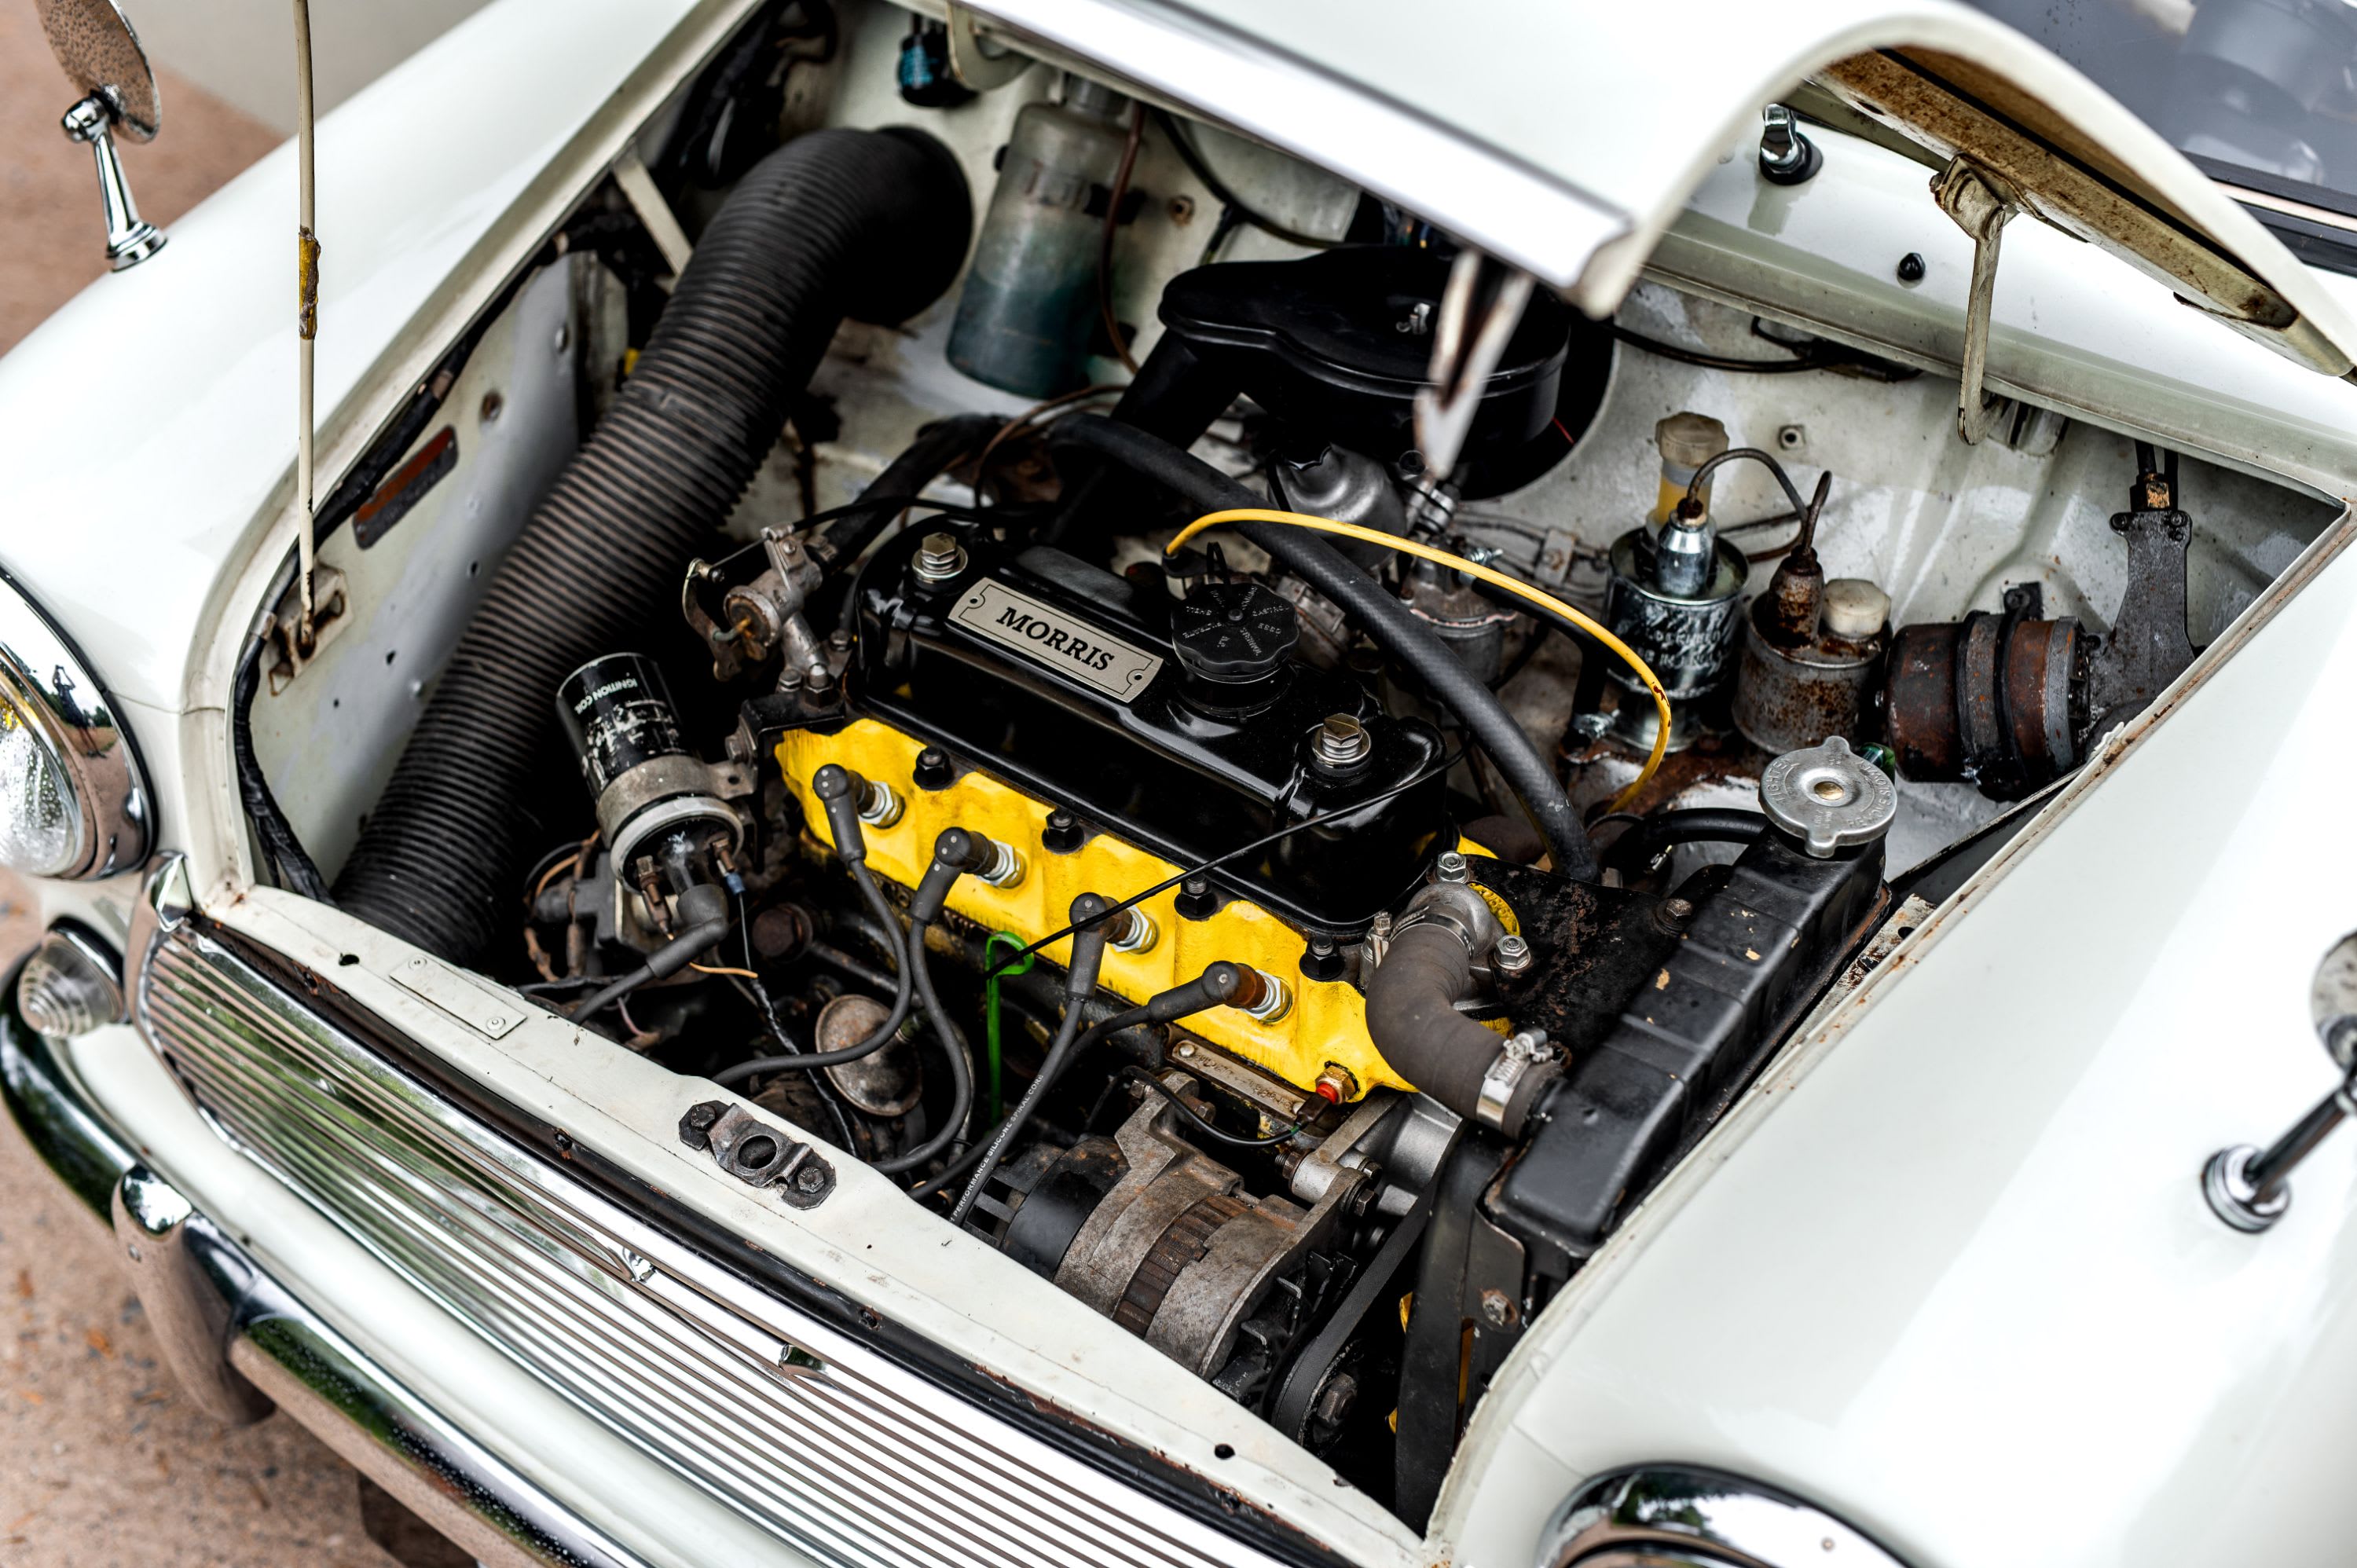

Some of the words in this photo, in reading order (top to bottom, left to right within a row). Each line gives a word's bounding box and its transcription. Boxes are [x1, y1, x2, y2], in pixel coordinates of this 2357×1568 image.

[995, 606, 1116, 672] MORRIS
[592, 678, 638, 701] IGNITION
[952, 1156, 989, 1218] PERFORMANCE
[988, 1121, 1014, 1157] SILICONE
[1010, 1096, 1031, 1122] SPIRAL
[1028, 1073, 1044, 1096] CORE
